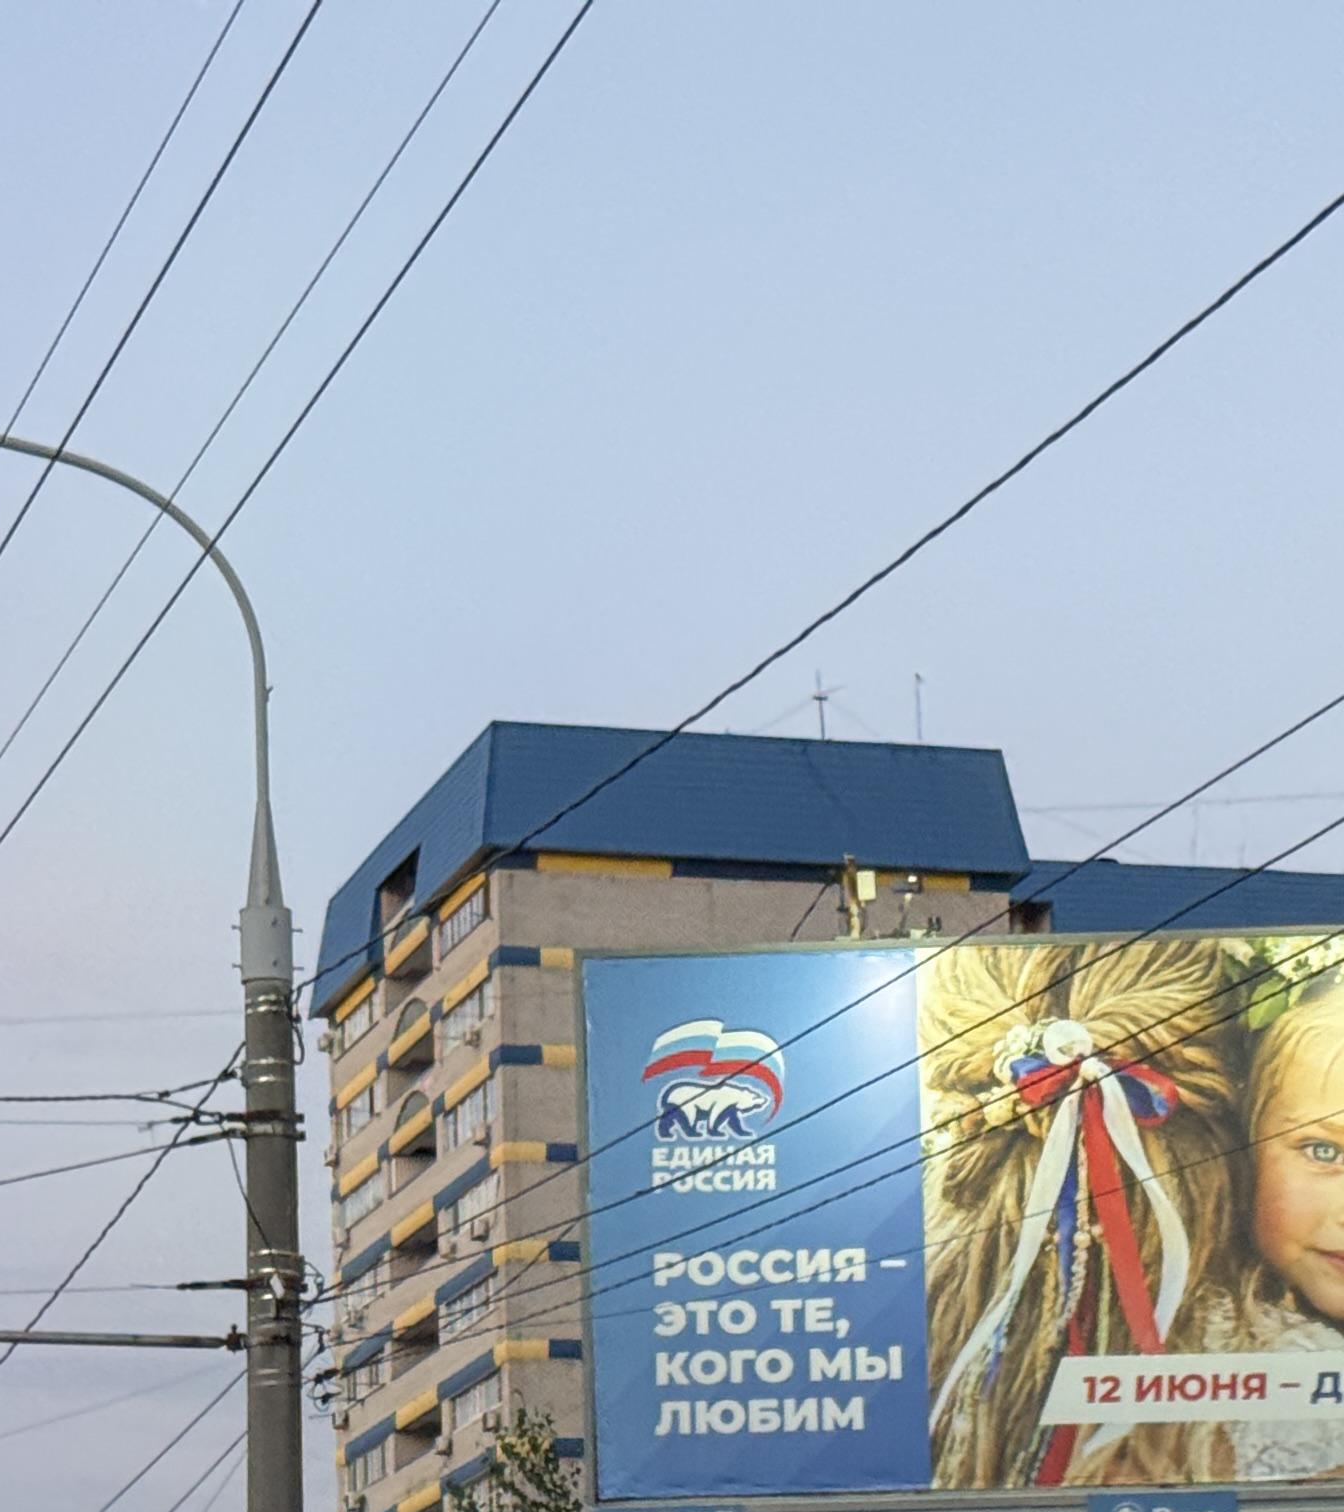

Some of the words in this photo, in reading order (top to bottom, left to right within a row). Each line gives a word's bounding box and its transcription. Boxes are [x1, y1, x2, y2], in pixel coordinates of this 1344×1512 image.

[652, 1144, 775, 1167] ЕДИНАЯ
[652, 1168, 776, 1193] РОССИЯ
[654, 1248, 866, 1286] РОССИЯ
[654, 1300, 757, 1336] ЭТО
[771, 1298, 850, 1339] ТЕ,
[656, 1349, 793, 1386] КОГО
[809, 1346, 903, 1382] МЫ
[1083, 1375, 1121, 1403] 12
[1135, 1372, 1267, 1402] ИЮНЯ
[654, 1397, 865, 1435] ЛЮБИМ
